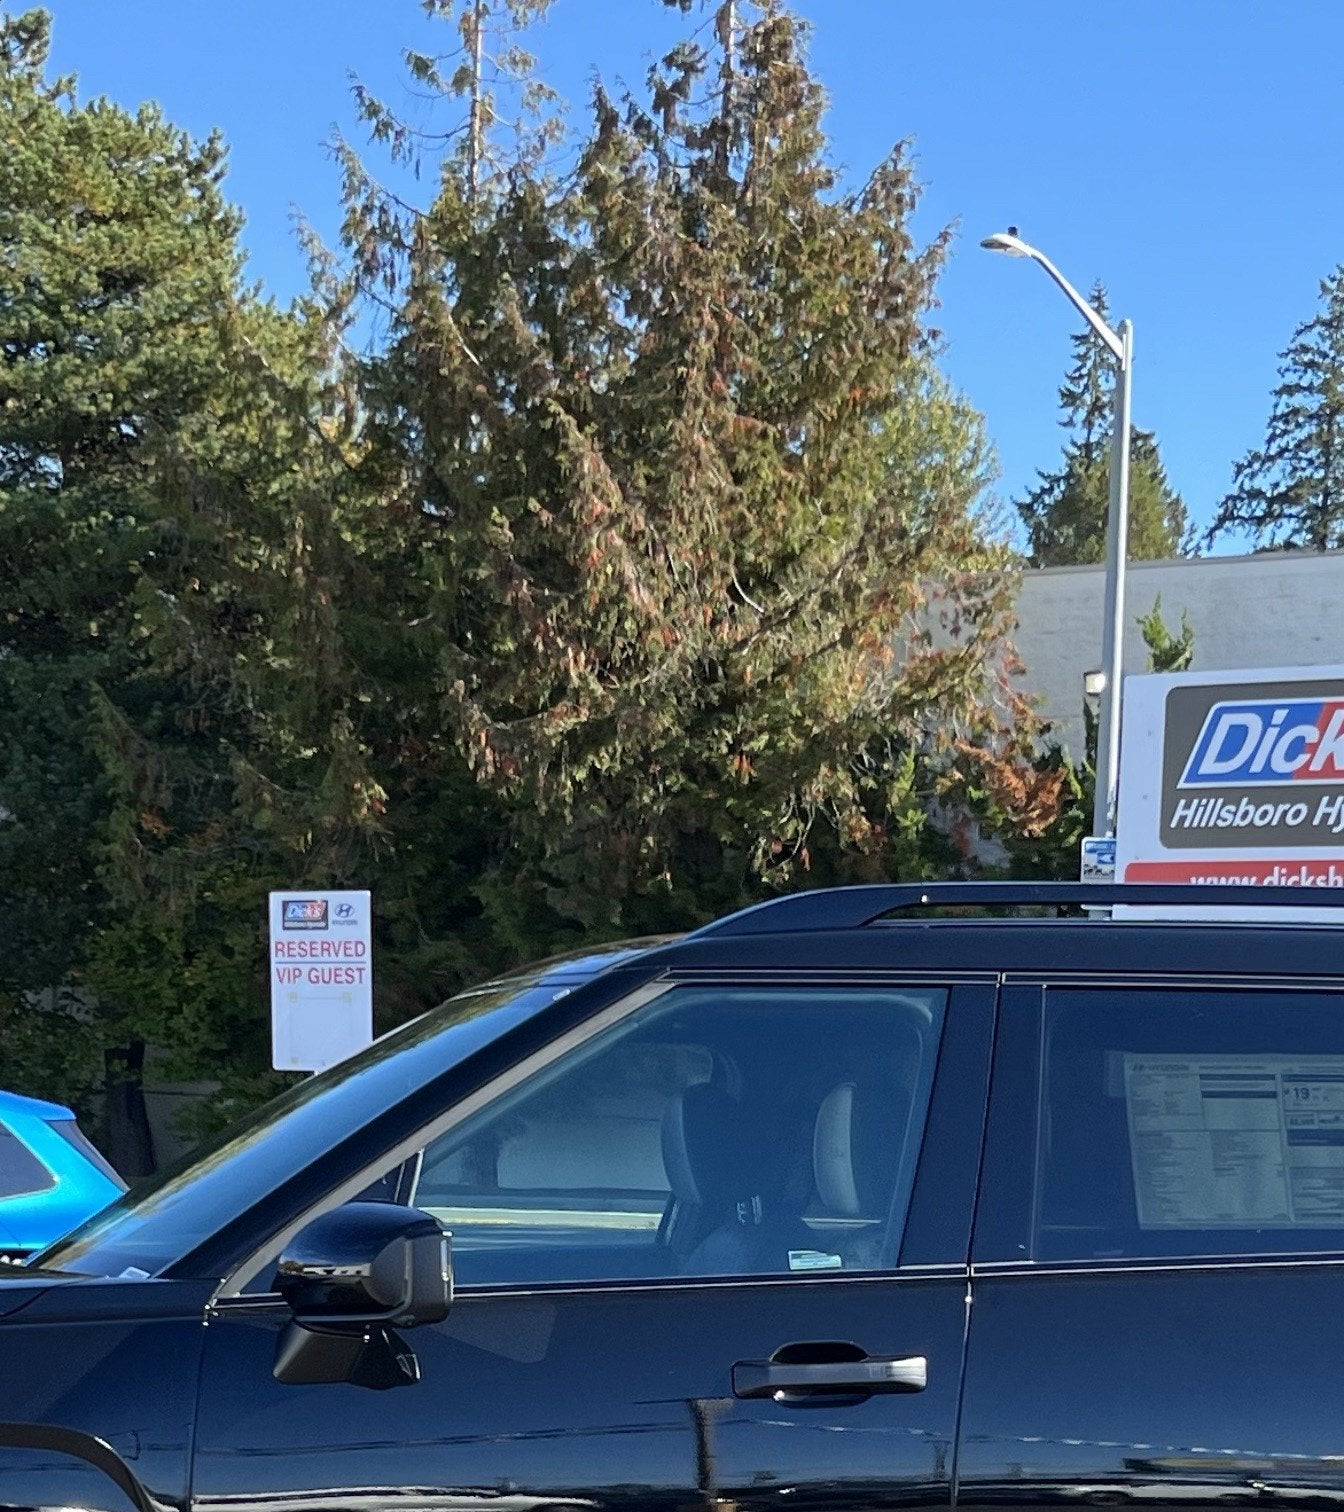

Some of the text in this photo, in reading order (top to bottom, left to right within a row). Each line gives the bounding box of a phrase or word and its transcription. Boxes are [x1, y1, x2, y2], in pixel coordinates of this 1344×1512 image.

[1170, 798, 1309, 828] Hillsboro
[275, 941, 366, 957] RESERVED
[276, 967, 366, 984] VIP GUEST
